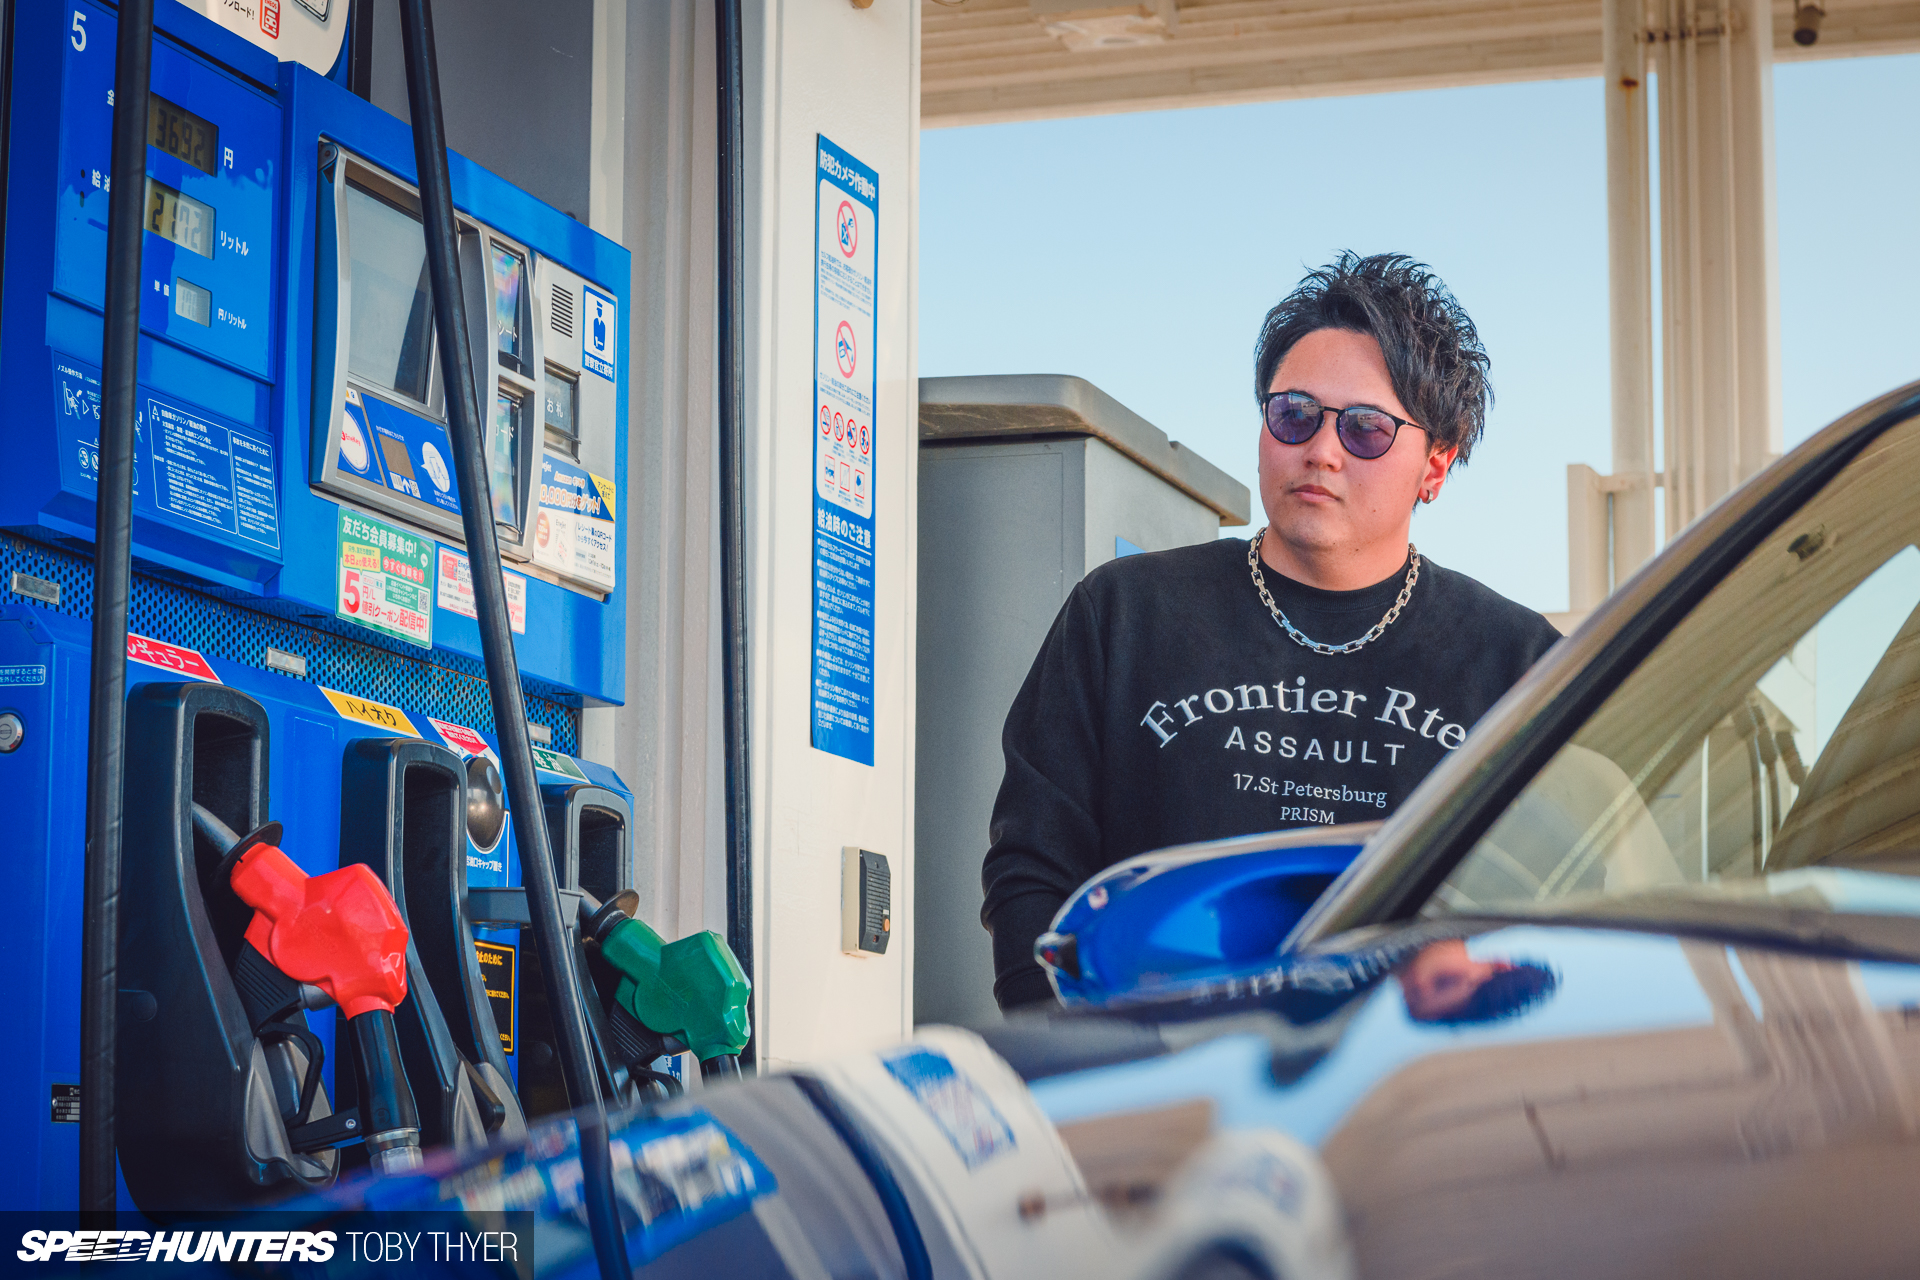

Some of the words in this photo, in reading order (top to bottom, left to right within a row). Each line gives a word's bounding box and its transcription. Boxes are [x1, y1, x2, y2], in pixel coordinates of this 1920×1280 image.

[71, 10, 86, 51] 5
[156, 108, 206, 167] 3692
[224, 147, 233, 169] 円
[820, 148, 876, 202] 防犯カメラ作動中
[220, 230, 249, 256] リットル
[584, 354, 614, 379] 警察官立寄所
[547, 398, 563, 418] お札
[343, 515, 417, 558] 友だち会員募集中!
[817, 507, 872, 549] 給油時のご注意
[344, 553, 379, 568] 本日より使える!
[343, 570, 360, 614] 5
[362, 600, 427, 634] 値引クーポン配信中!
[345, 699, 397, 727] ハイオク
[1140, 676, 1367, 748] Frontier
[1374, 686, 1466, 750] Rte
[1224, 726, 1405, 766] ASSAULT
[1233, 773, 1279, 796] 17.St
[1282, 780, 1388, 808] Petersburg
[1280, 806, 1335, 825] PRISM
